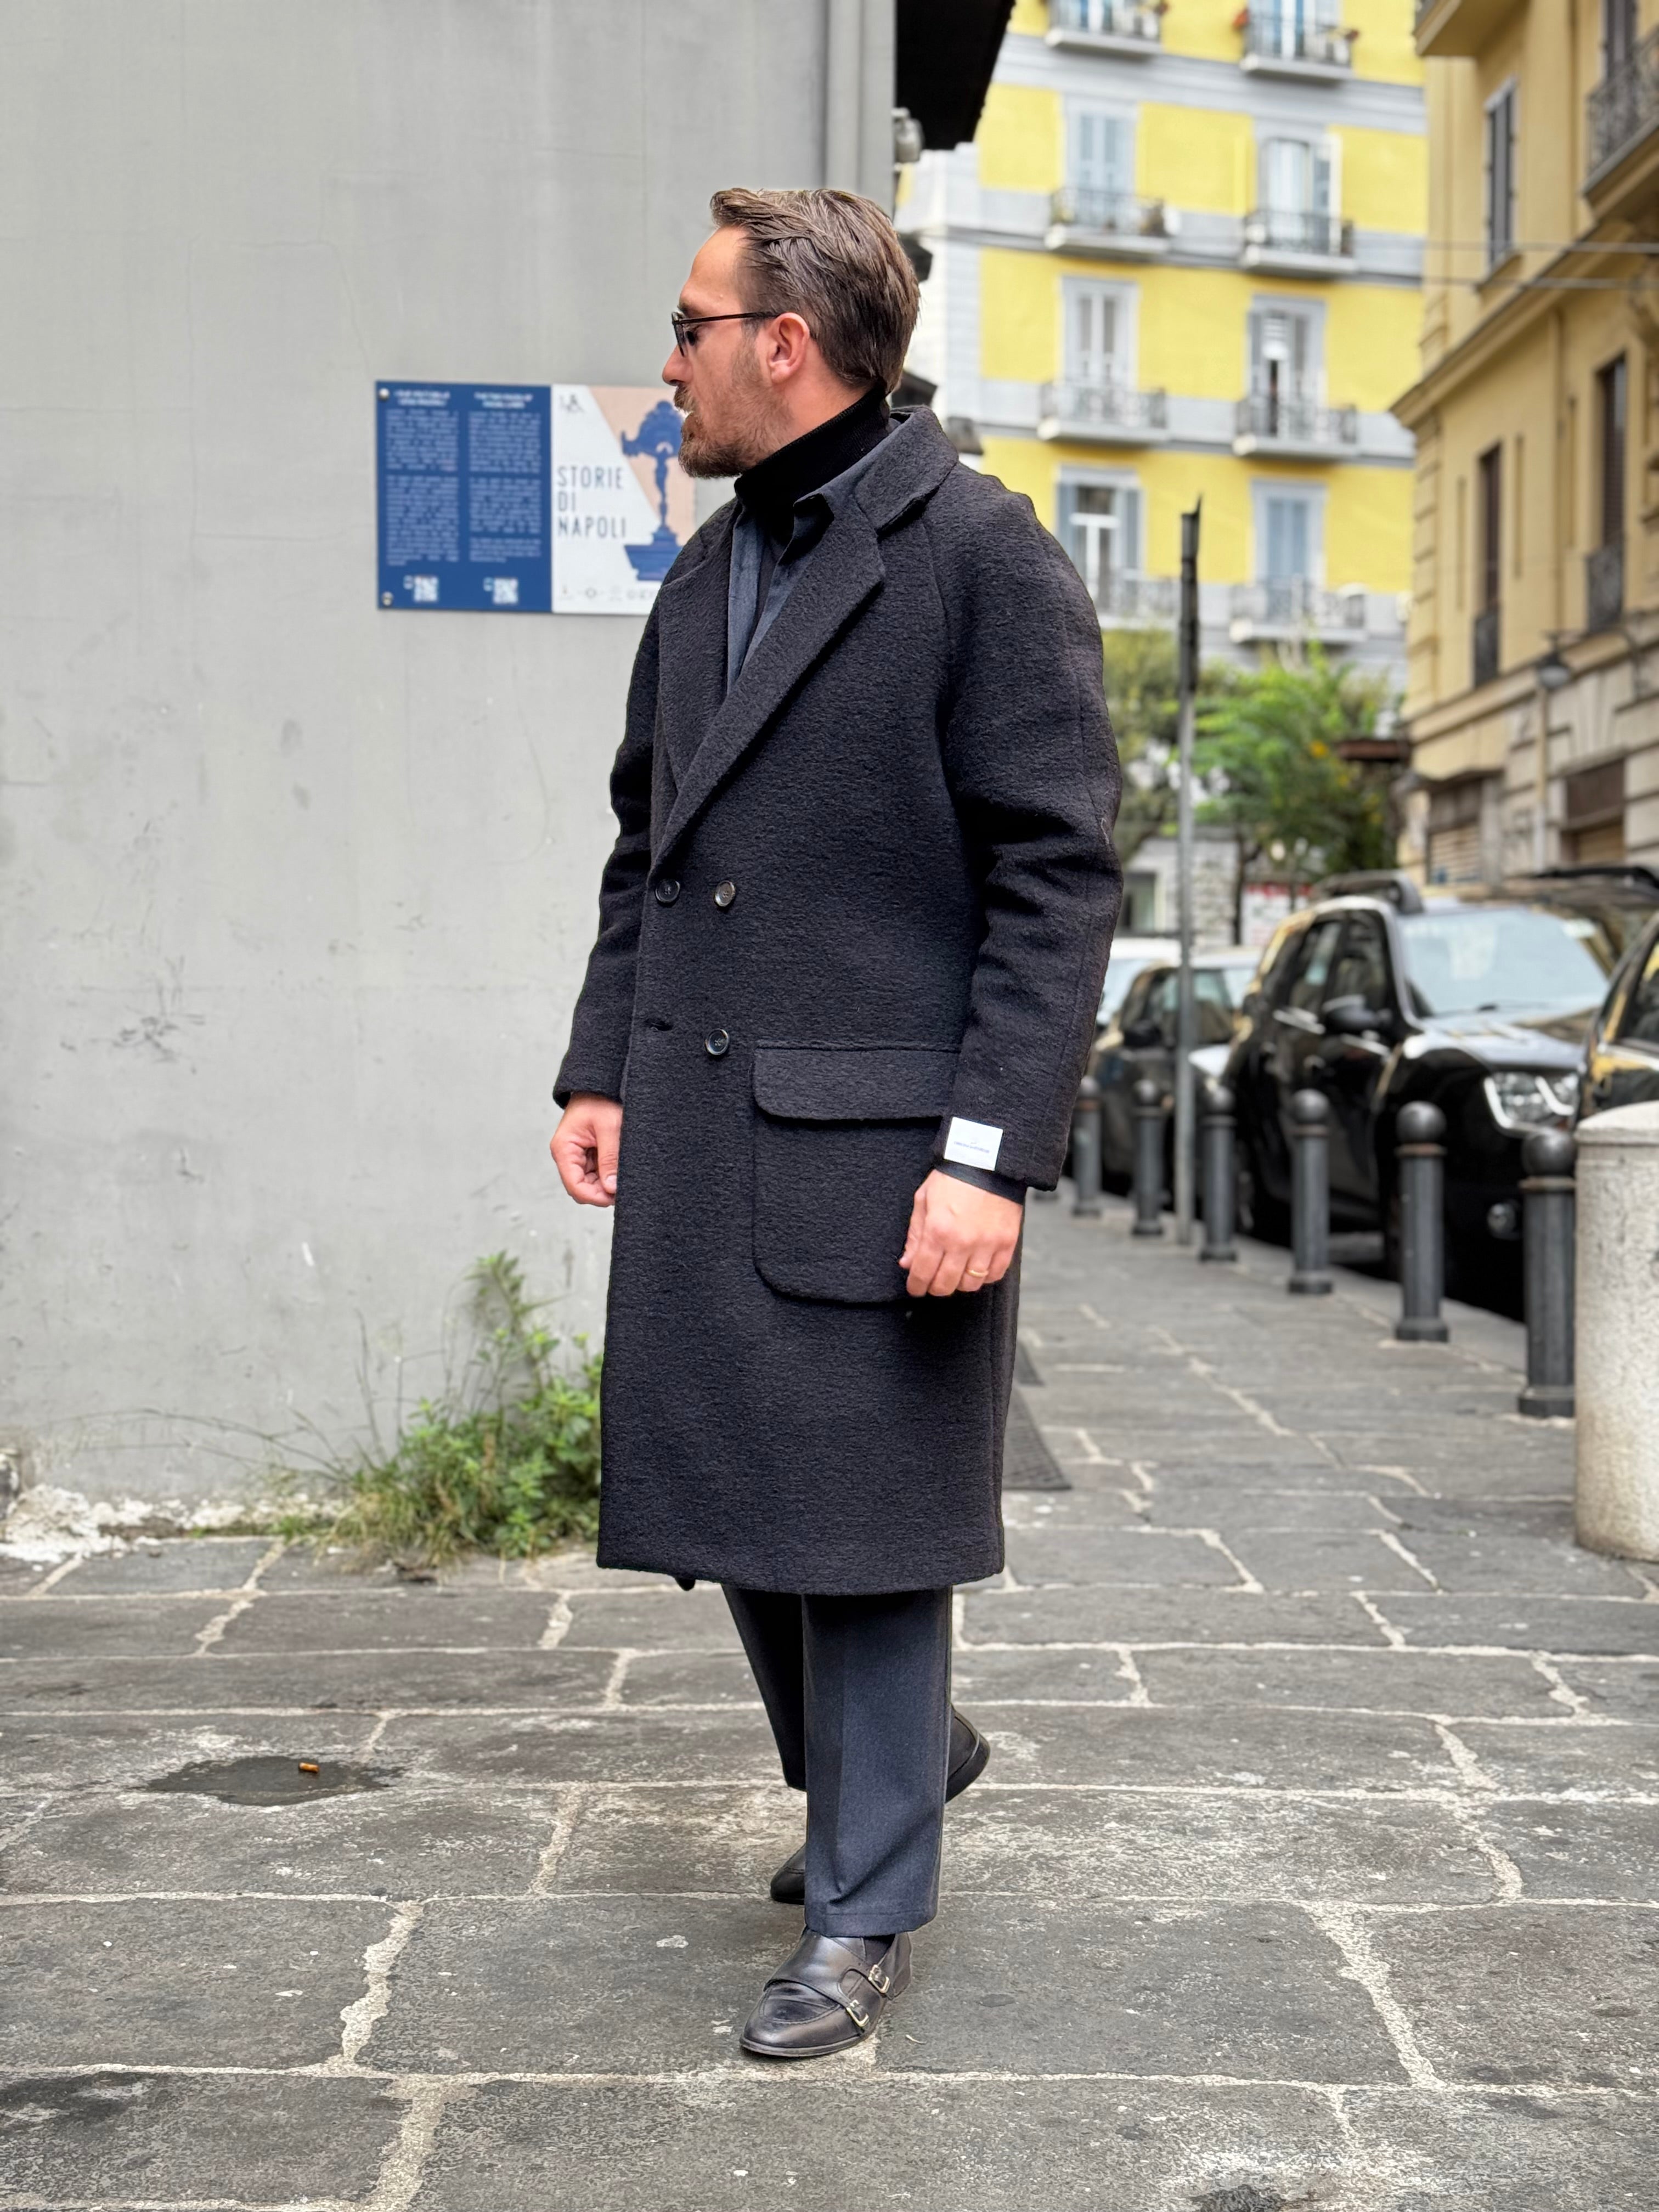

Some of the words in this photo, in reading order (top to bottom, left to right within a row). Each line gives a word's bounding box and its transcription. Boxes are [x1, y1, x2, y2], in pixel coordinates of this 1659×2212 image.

[557, 466, 623, 489] STORIE
[558, 491, 576, 512] DI
[558, 517, 627, 538] NAPOLI
